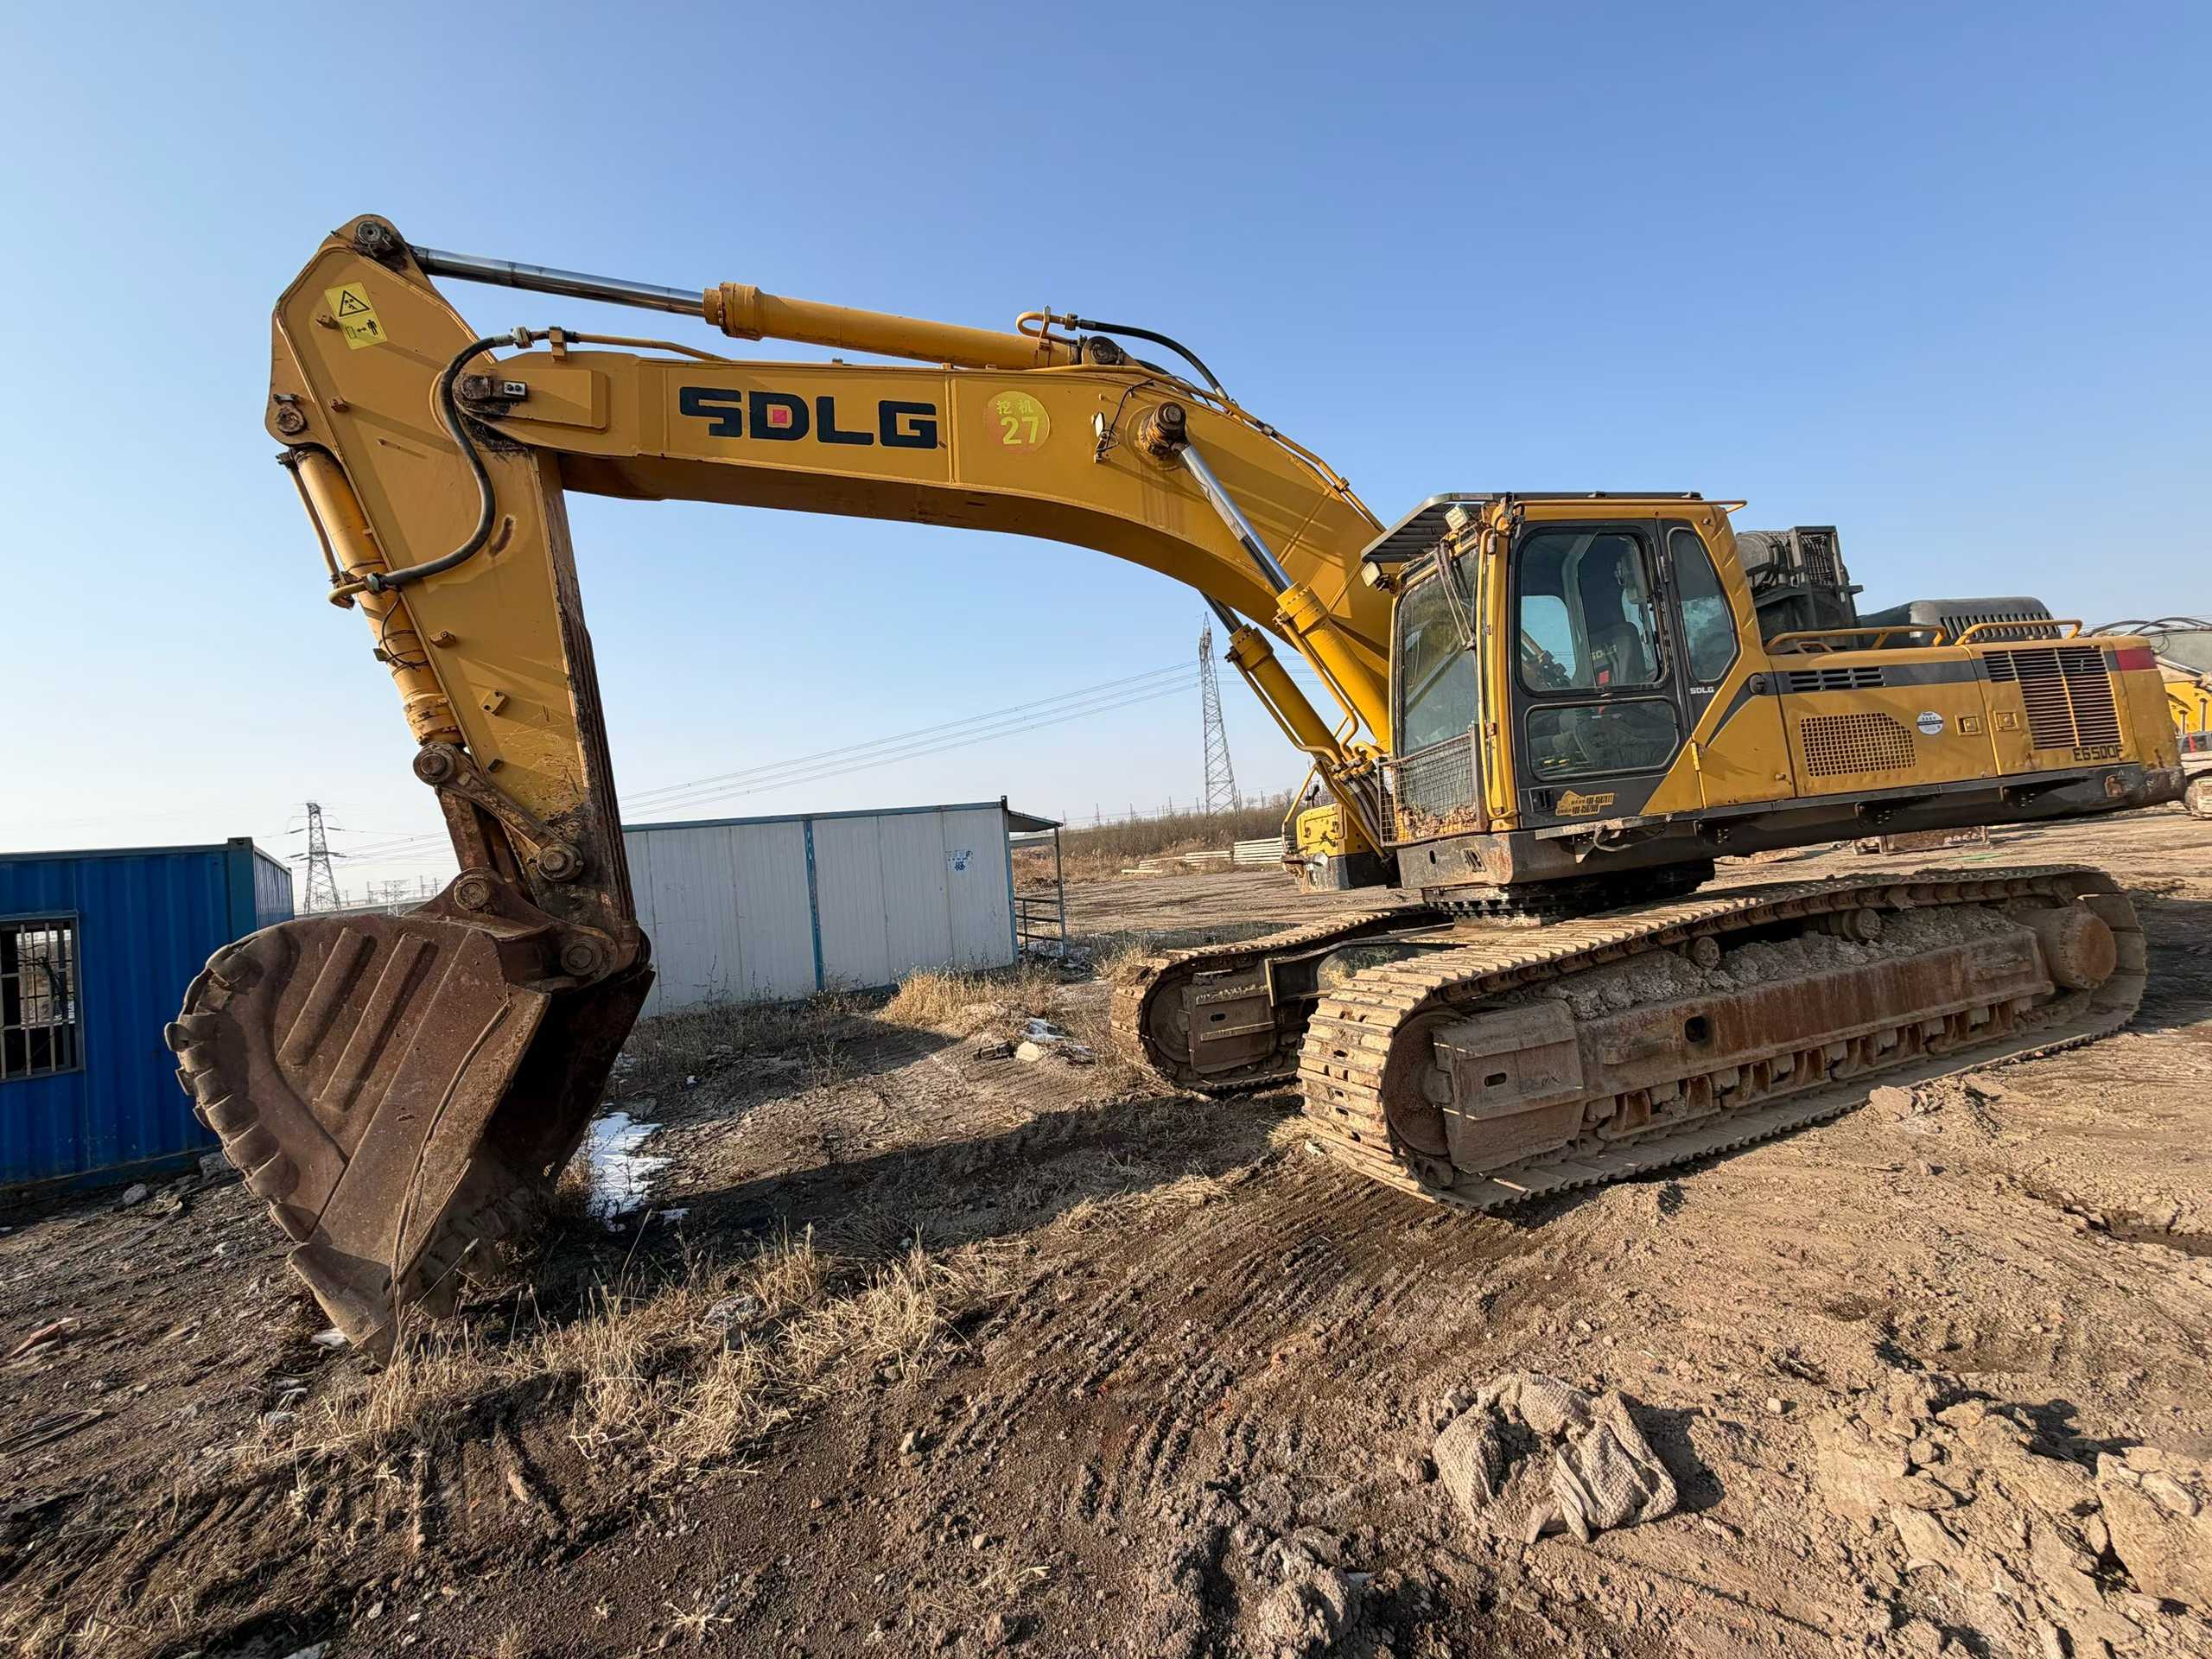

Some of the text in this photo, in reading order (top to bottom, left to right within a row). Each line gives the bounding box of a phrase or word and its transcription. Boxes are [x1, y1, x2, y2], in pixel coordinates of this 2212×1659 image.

[996, 400, 1034, 415] 挖机
[679, 386, 938, 449] SDLG
[1001, 416, 1039, 444] 27
[1689, 686, 1715, 695] SDLG
[2073, 744, 2123, 761] E6500F
